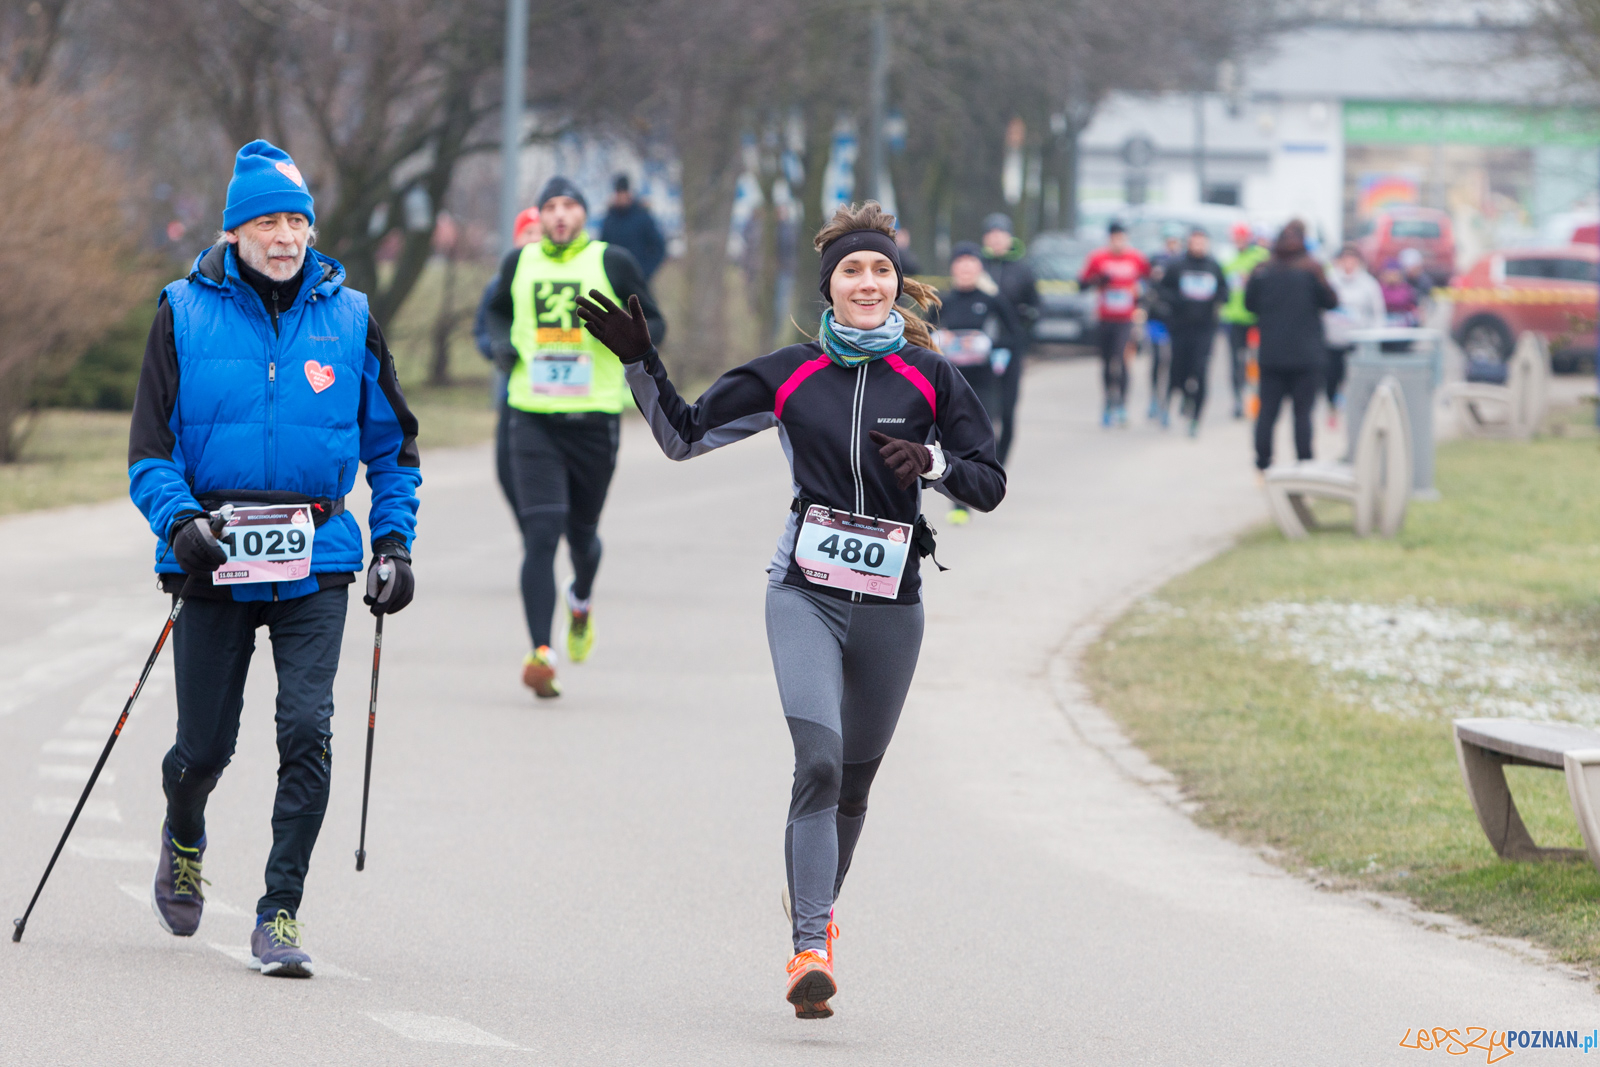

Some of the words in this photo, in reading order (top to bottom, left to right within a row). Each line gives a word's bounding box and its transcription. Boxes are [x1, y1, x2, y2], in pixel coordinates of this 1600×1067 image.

[227, 529, 306, 557] 1029
[817, 534, 885, 568] 480
[219, 571, 248, 579] 11.02.2018
